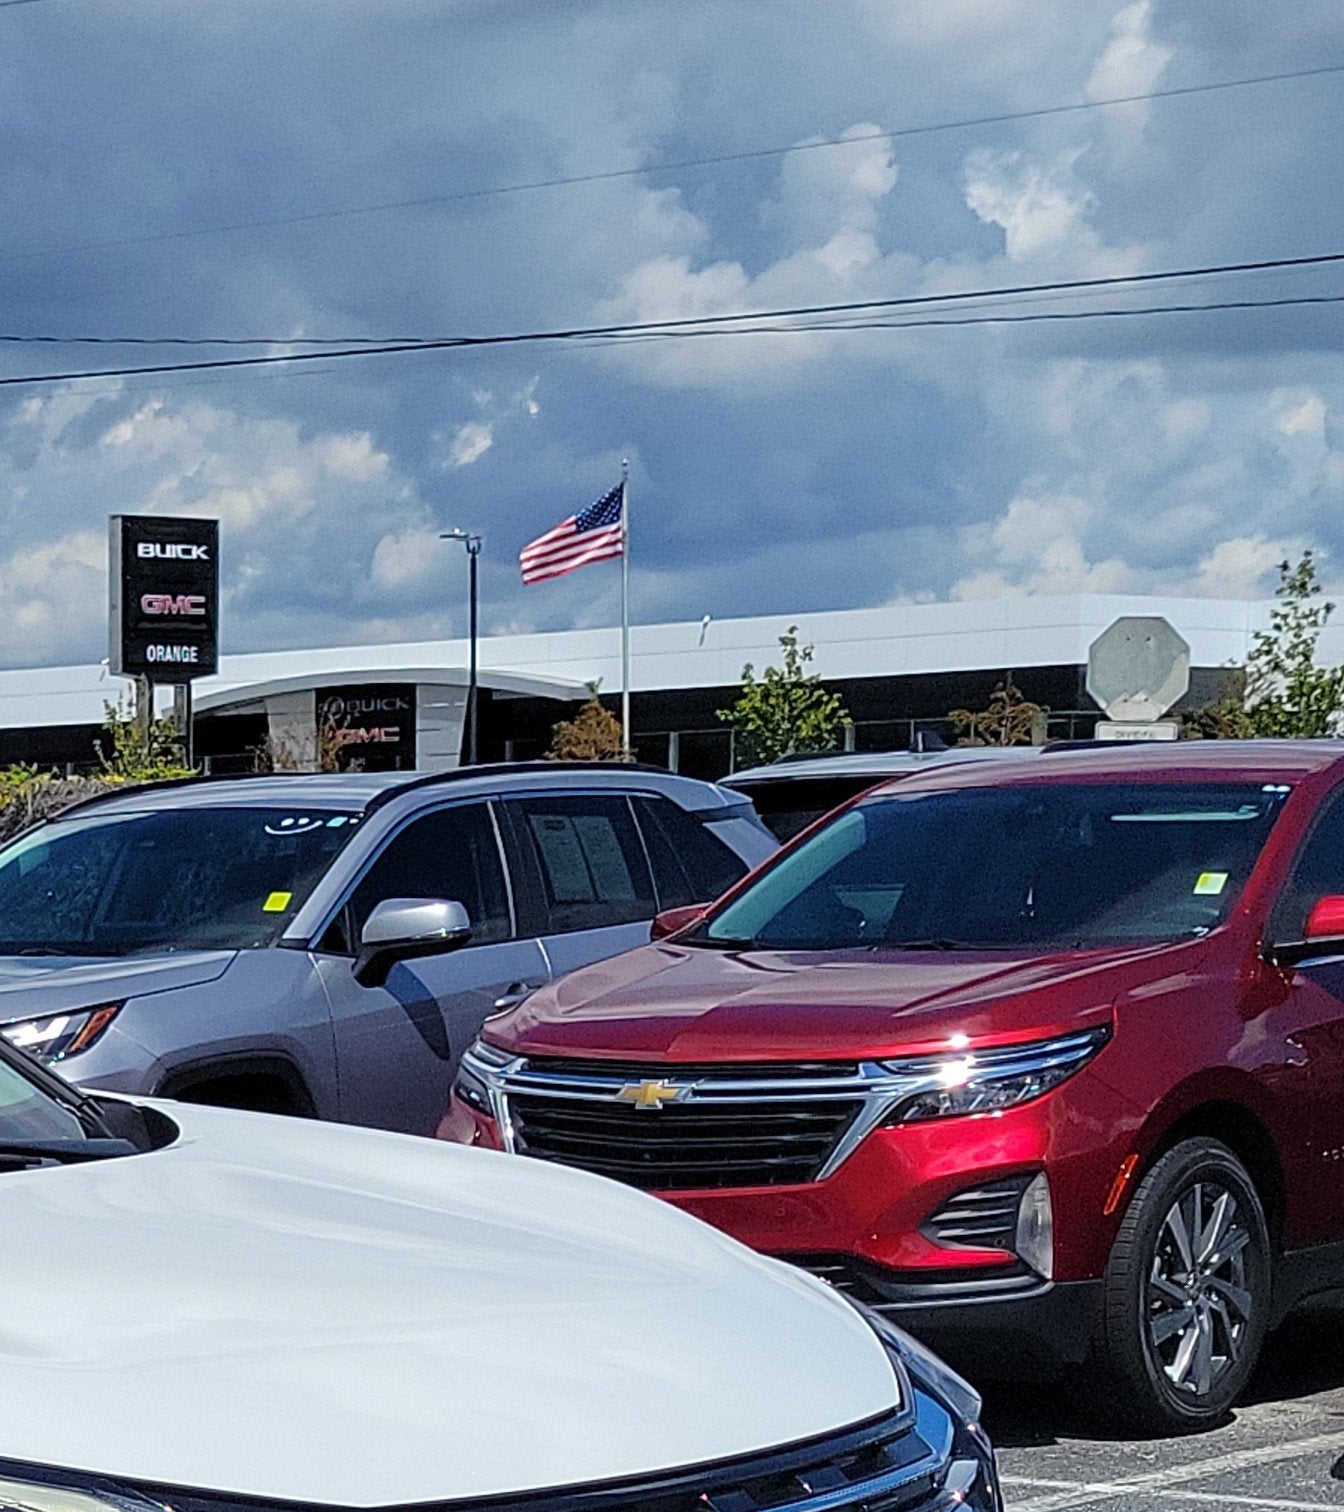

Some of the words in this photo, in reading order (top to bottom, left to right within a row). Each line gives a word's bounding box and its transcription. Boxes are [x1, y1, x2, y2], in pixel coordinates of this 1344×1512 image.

[137, 542, 209, 560] BUICK
[140, 594, 206, 615] GMC
[146, 645, 198, 663] ORANGE
